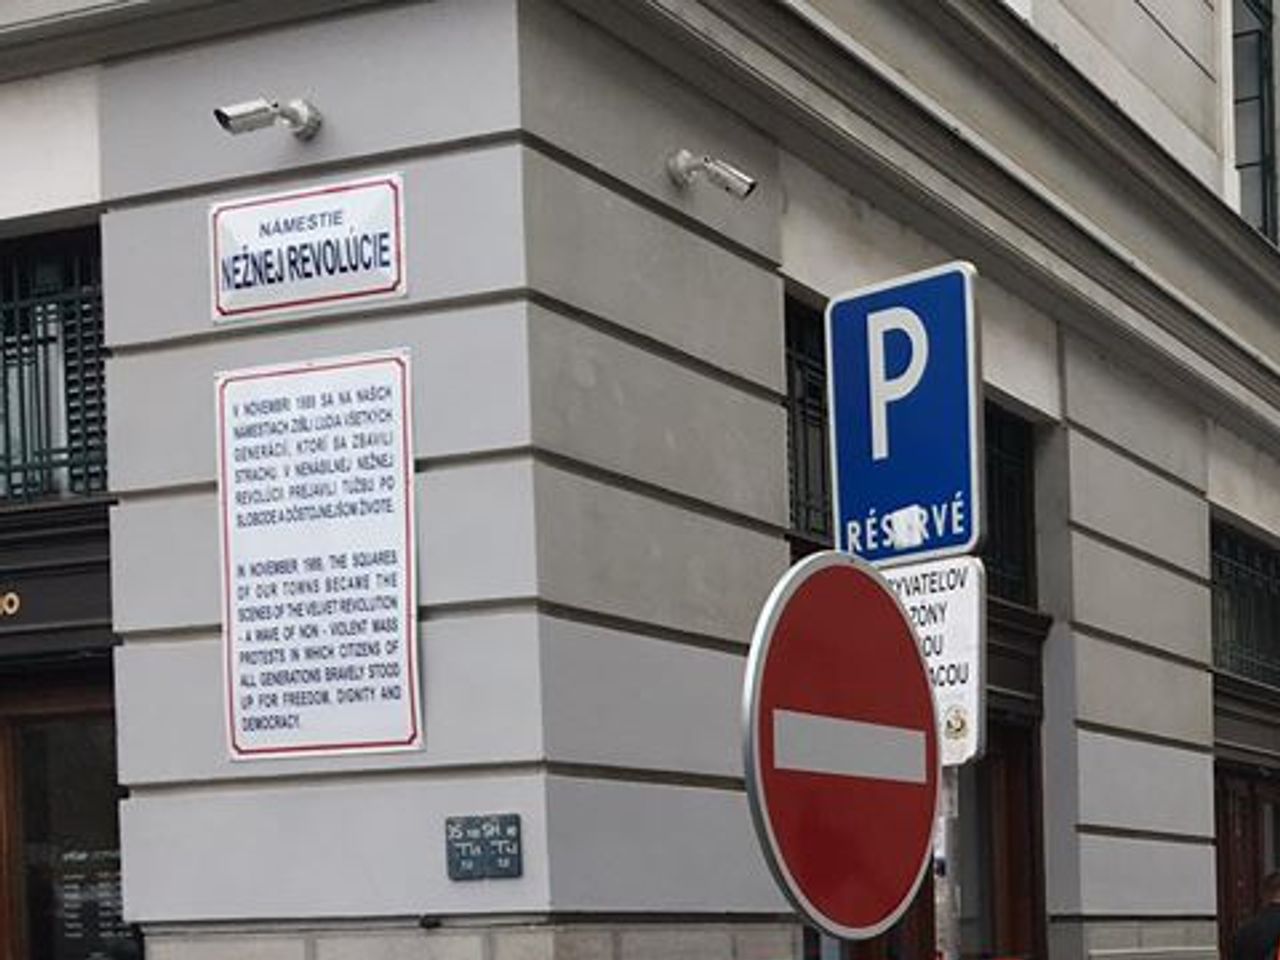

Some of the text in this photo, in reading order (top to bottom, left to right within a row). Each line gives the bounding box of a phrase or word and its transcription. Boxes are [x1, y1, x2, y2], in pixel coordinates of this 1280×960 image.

[221, 226, 391, 291] NEŽNEJ REVOLÚCIE
[867, 307, 928, 461] P
[847, 491, 965, 552] RÉSRVÉ
